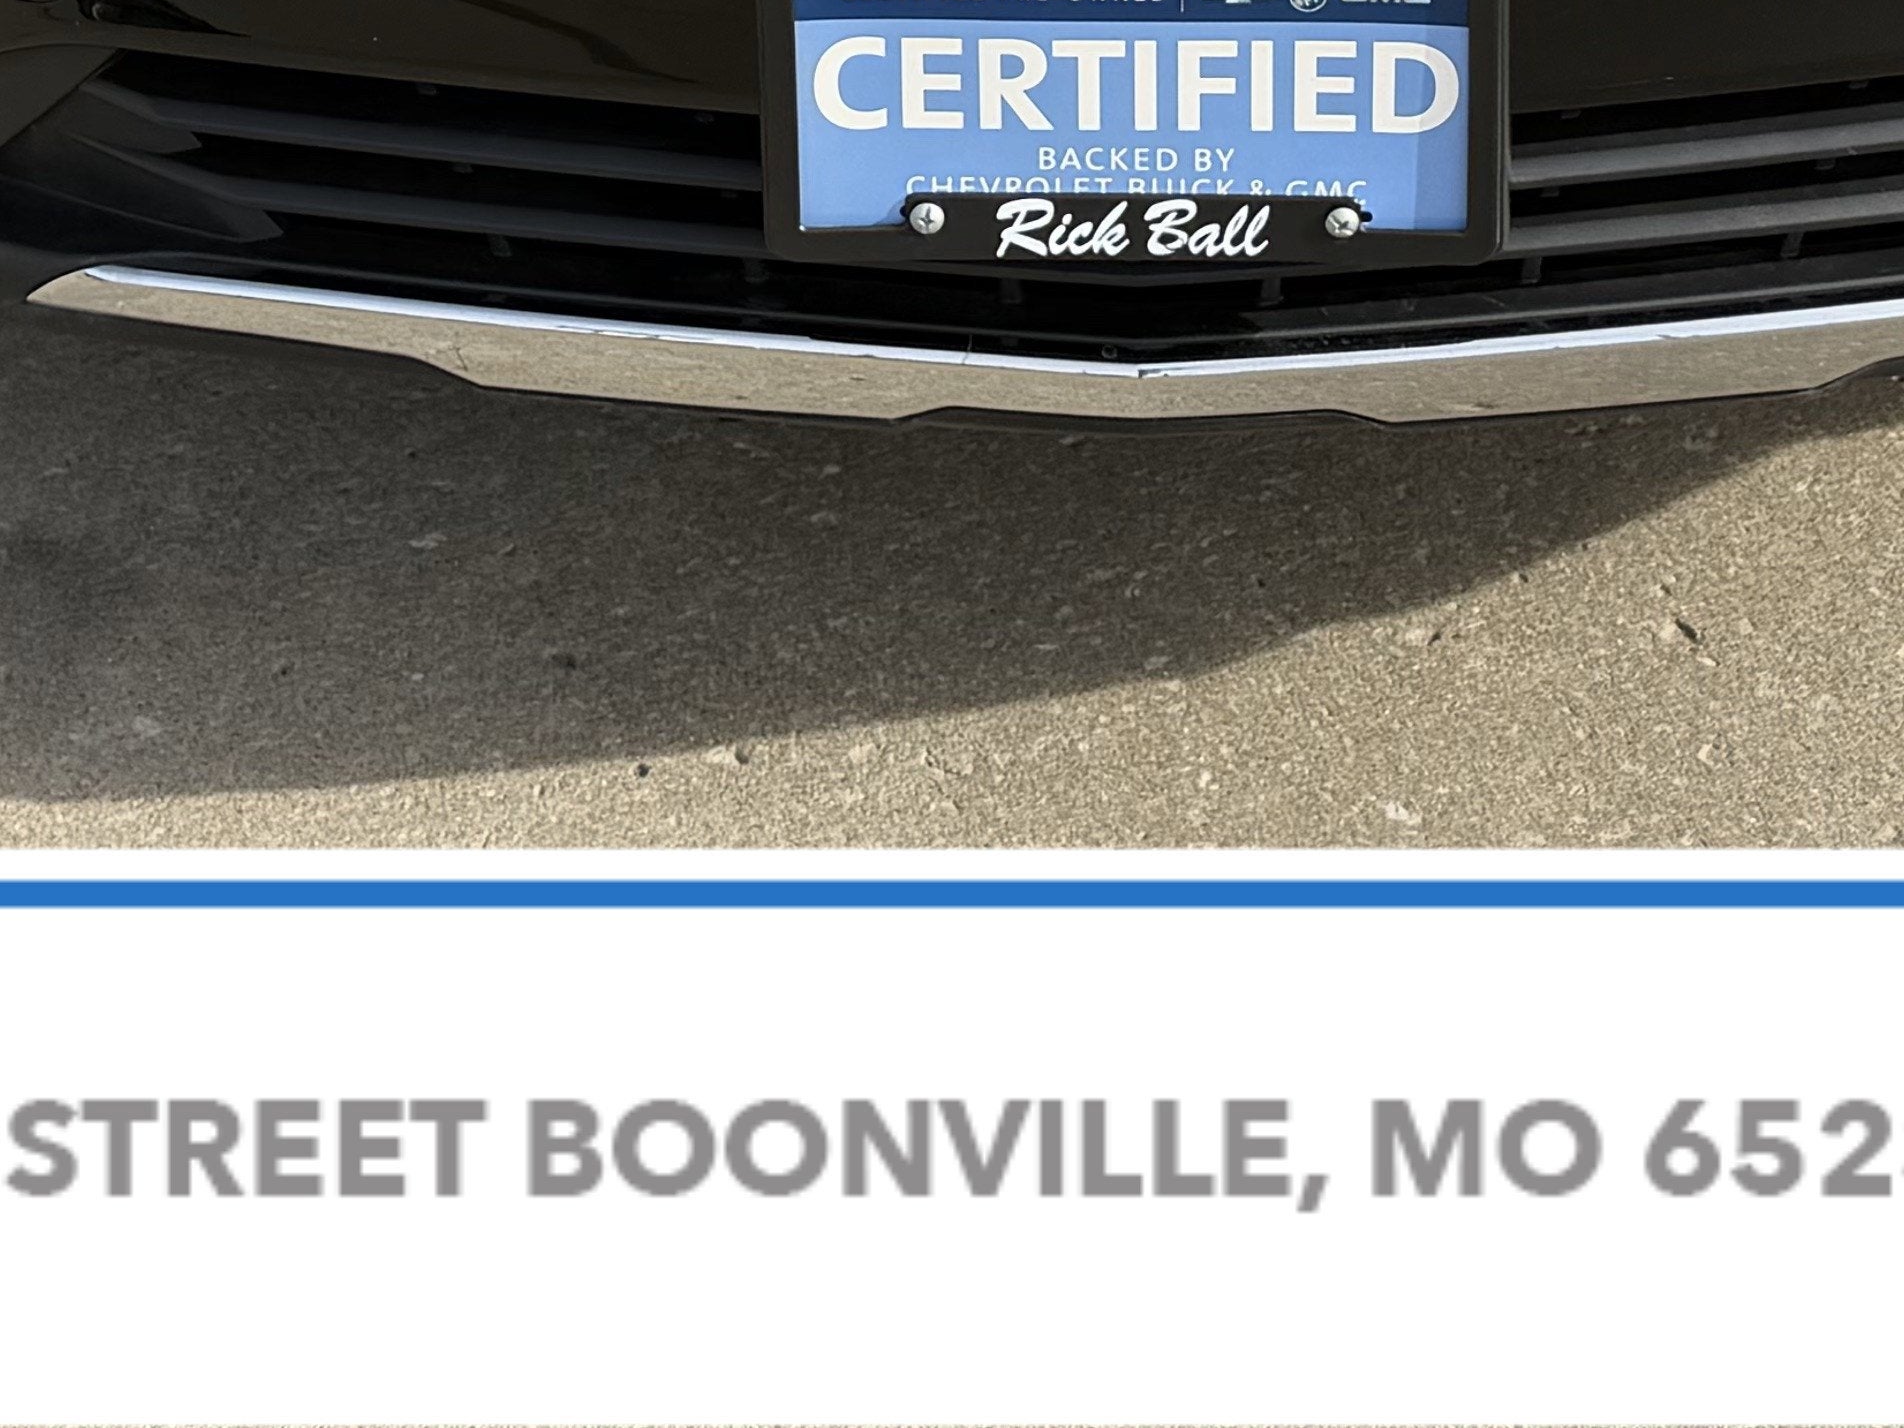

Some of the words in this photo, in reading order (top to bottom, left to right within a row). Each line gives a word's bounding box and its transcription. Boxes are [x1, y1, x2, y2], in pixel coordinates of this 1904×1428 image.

[813, 36, 1460, 134] CERTIFIED
[1038, 146, 1178, 172] BACKED
[1194, 148, 1235, 172] BY
[996, 197, 1130, 258] Rick
[1143, 198, 1271, 258] Ball
